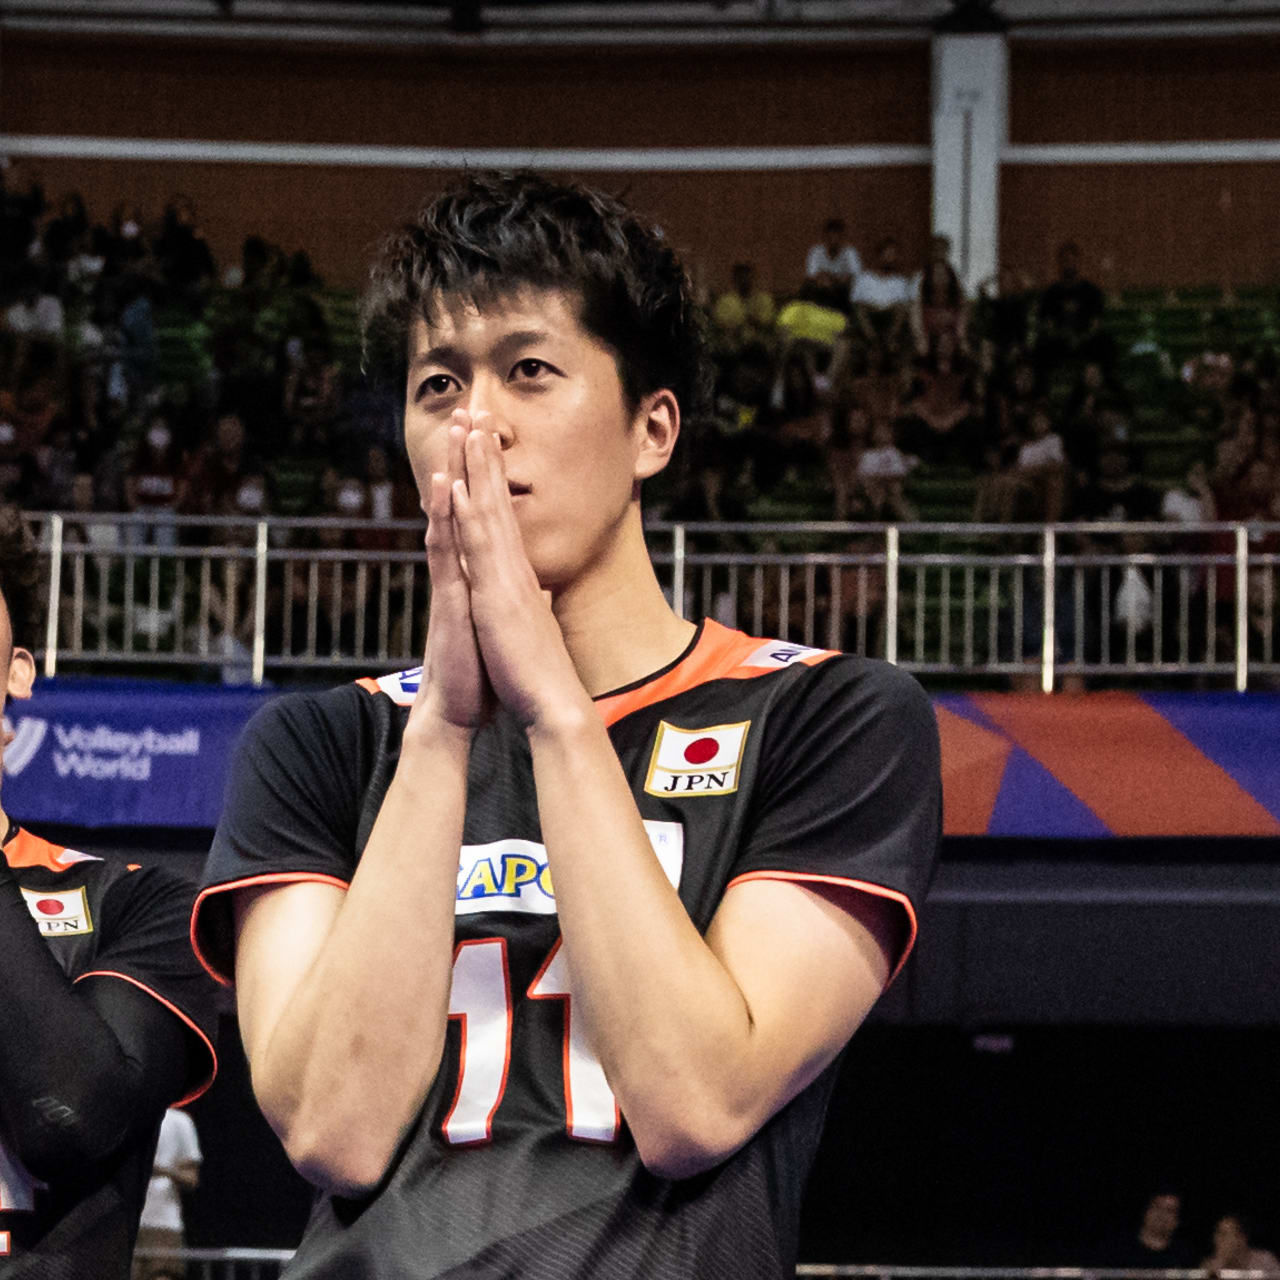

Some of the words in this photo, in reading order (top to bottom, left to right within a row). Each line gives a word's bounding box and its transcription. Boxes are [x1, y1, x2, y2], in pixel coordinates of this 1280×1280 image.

[52, 724, 200, 758] Volleyball
[53, 750, 151, 781] World
[663, 771, 729, 792] JPN
[46, 919, 79, 932] PN
[441, 936, 621, 1144] 11
